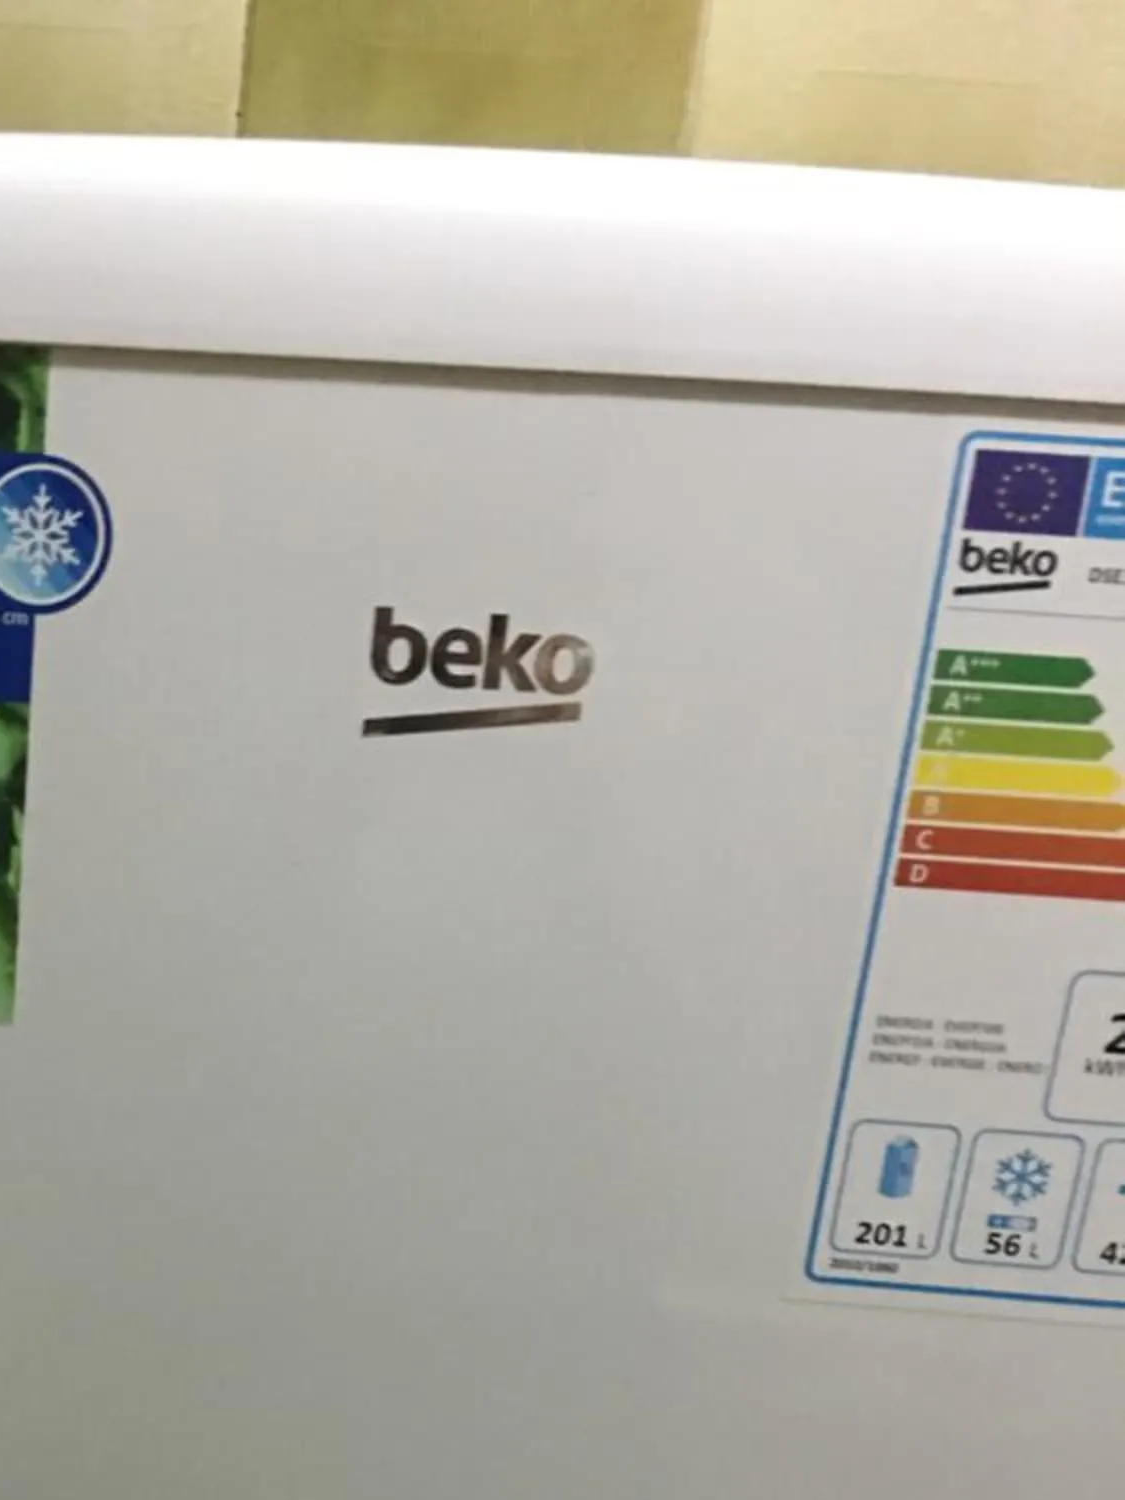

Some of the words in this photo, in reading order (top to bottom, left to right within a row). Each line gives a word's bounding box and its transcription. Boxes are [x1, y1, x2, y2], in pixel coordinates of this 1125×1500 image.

[959, 537, 1059, 577] beko
[2, 610, 30, 626] cm
[369, 605, 596, 696] beko
[915, 828, 935, 850] C
[909, 863, 930, 884] D
[854, 1221, 908, 1248] 201
[984, 1231, 1023, 1257] 56
